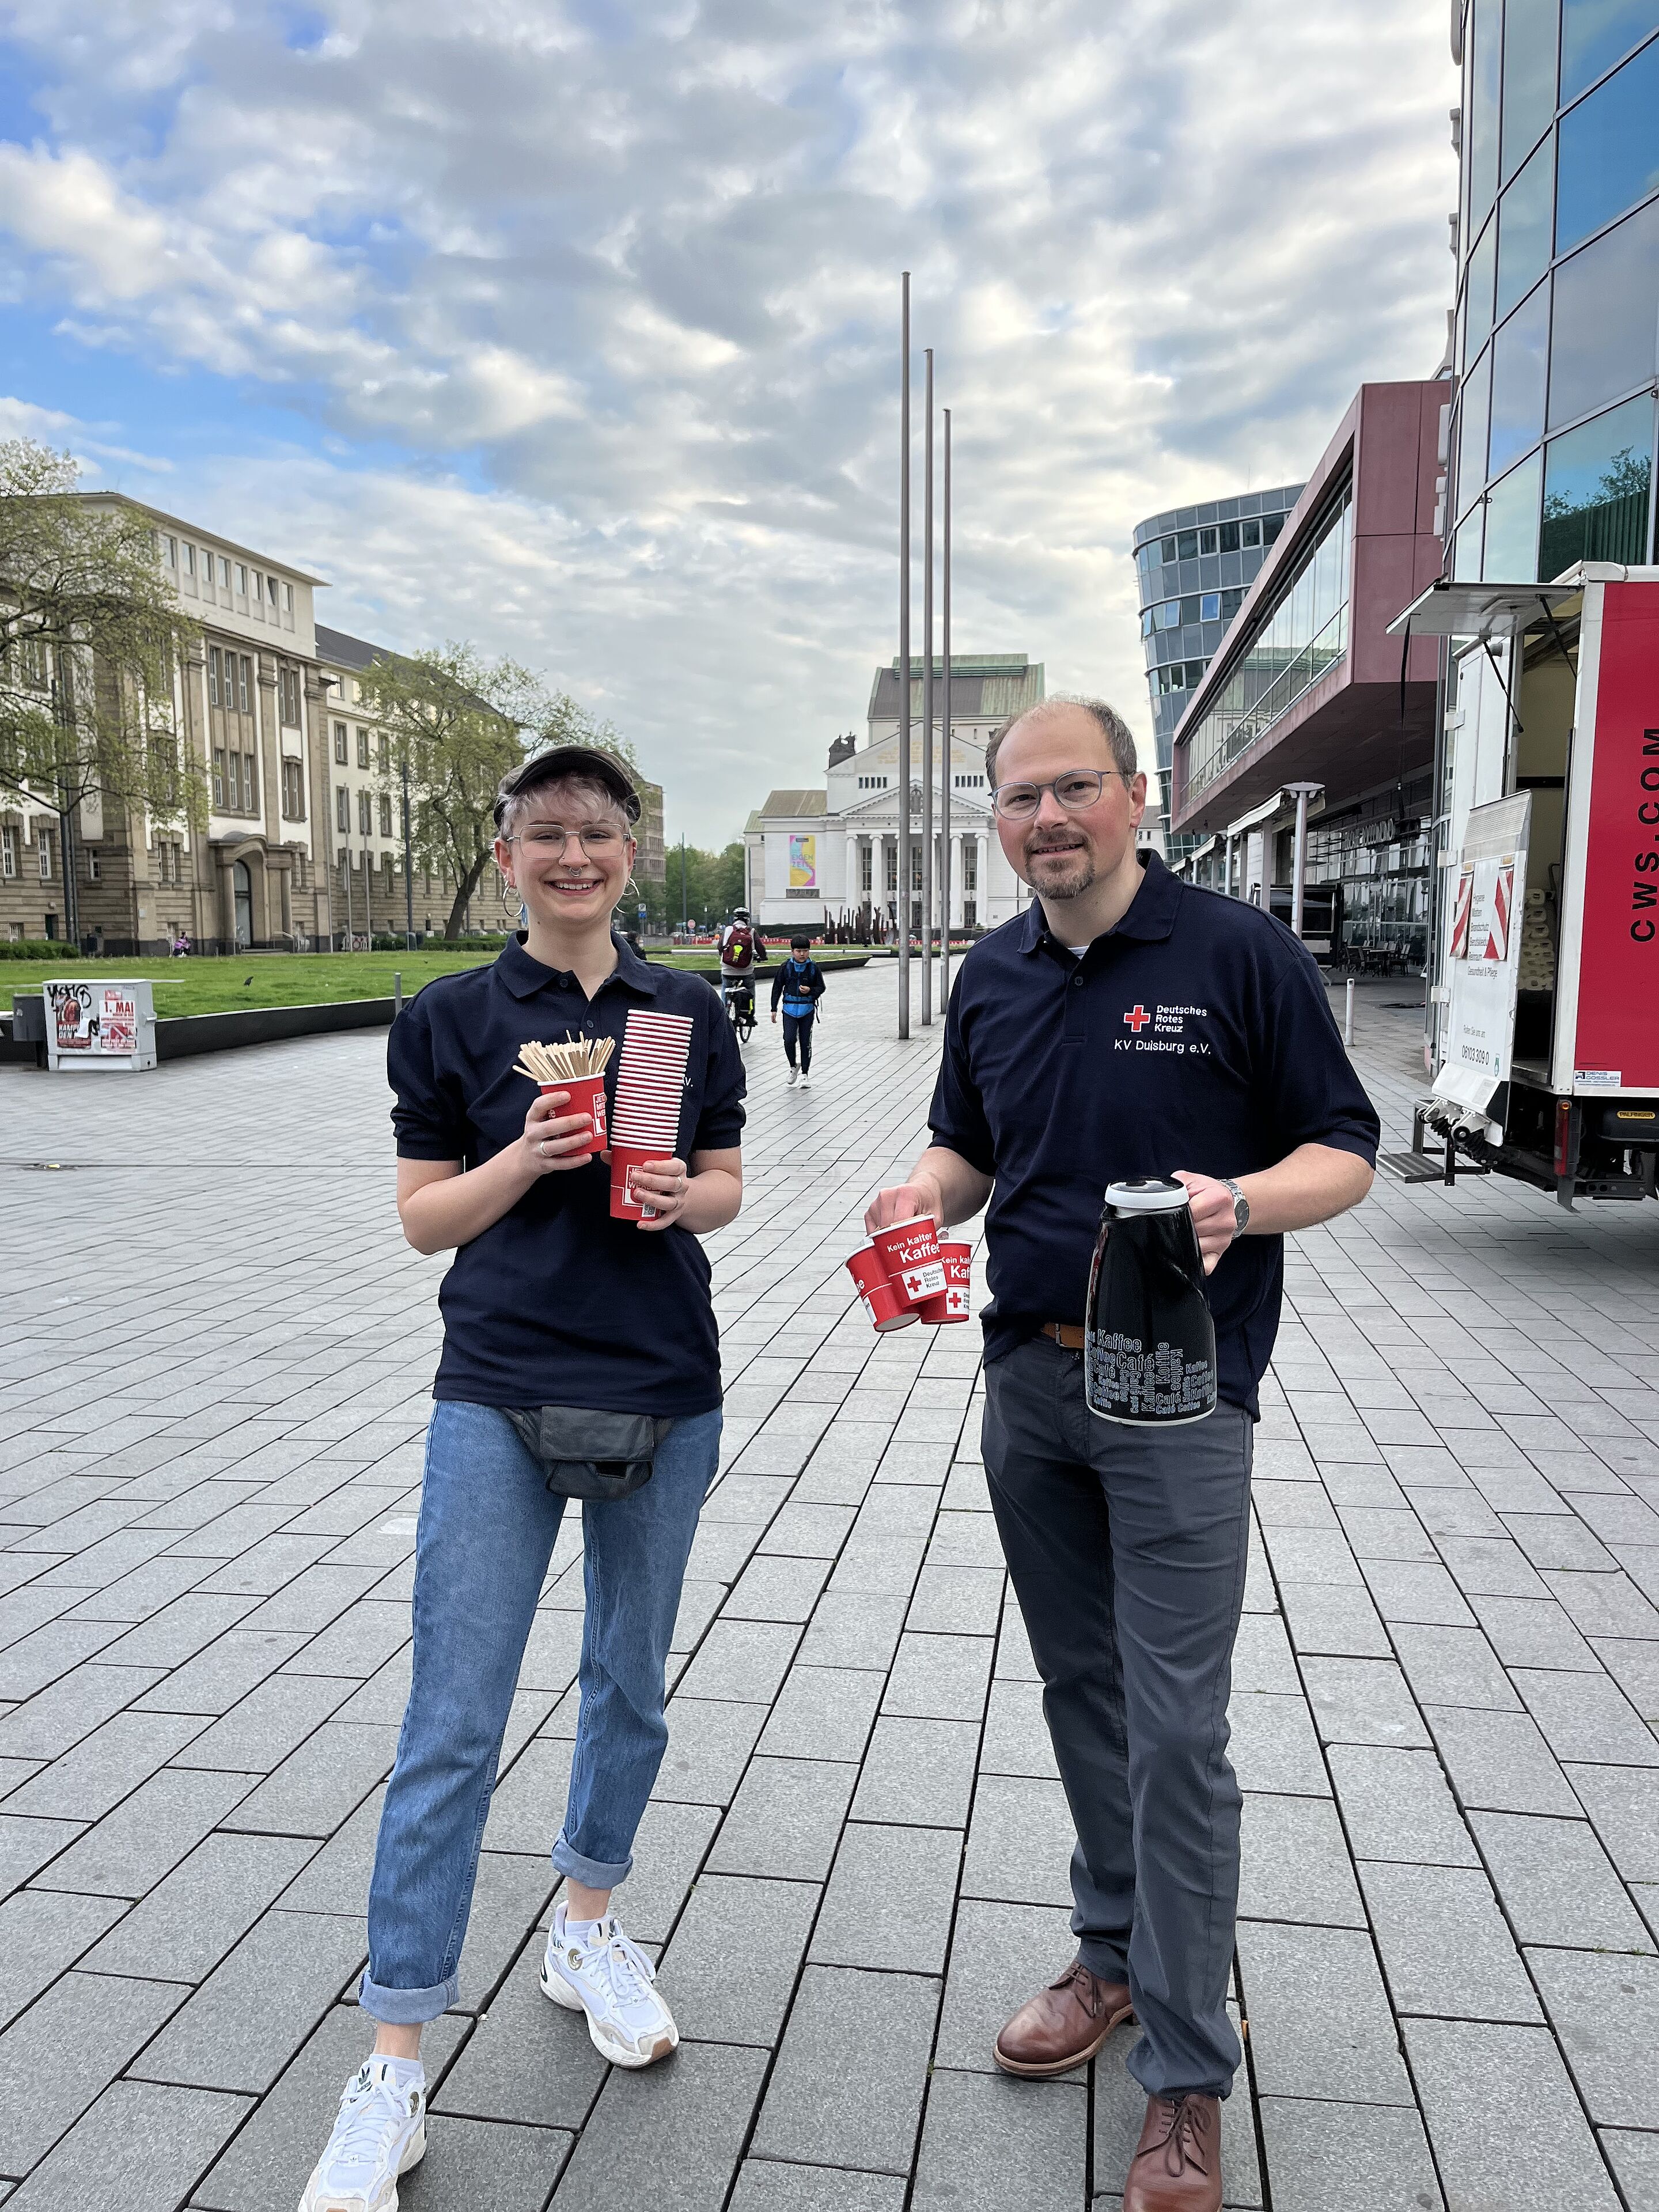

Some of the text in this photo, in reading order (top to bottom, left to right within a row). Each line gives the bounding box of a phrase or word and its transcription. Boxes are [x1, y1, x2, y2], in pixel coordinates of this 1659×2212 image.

[1630, 728, 1659, 943] CWS.COM
[104, 1002, 134, 1013] 1. MAI
[1156, 1005, 1207, 1017] Deutsches
[1154, 1024, 1183, 1033] Kreuz
[1156, 1014, 1183, 1024] Rotes
[1114, 1039, 1211, 1055] KV Duisburg e.V.
[1461, 1044, 1490, 1066] 06103 309 0
[887, 1232, 933, 1253] Kein kalter
[899, 1242, 940, 1264] Kaffee
[924, 1275, 939, 1283] Rotes
[926, 1281, 940, 1289] Kreuz
[1097, 1328, 1142, 1353] Kaffee
[1088, 1342, 1116, 1363] Coffee
[1116, 1351, 1155, 1372] Café
[1156, 1342, 1171, 1384] Koffie
[1093, 1358, 1116, 1378] Café
[1170, 1349, 1184, 1391] Kaffee
[1093, 1381, 1120, 1401] Coffee
[1119, 1369, 1130, 1402] Coffee
[1130, 1370, 1142, 1396] Café
[1142, 1371, 1155, 1411] Kaffee
[1156, 1391, 1181, 1406] Café
[1156, 1404, 1176, 1414] Café
